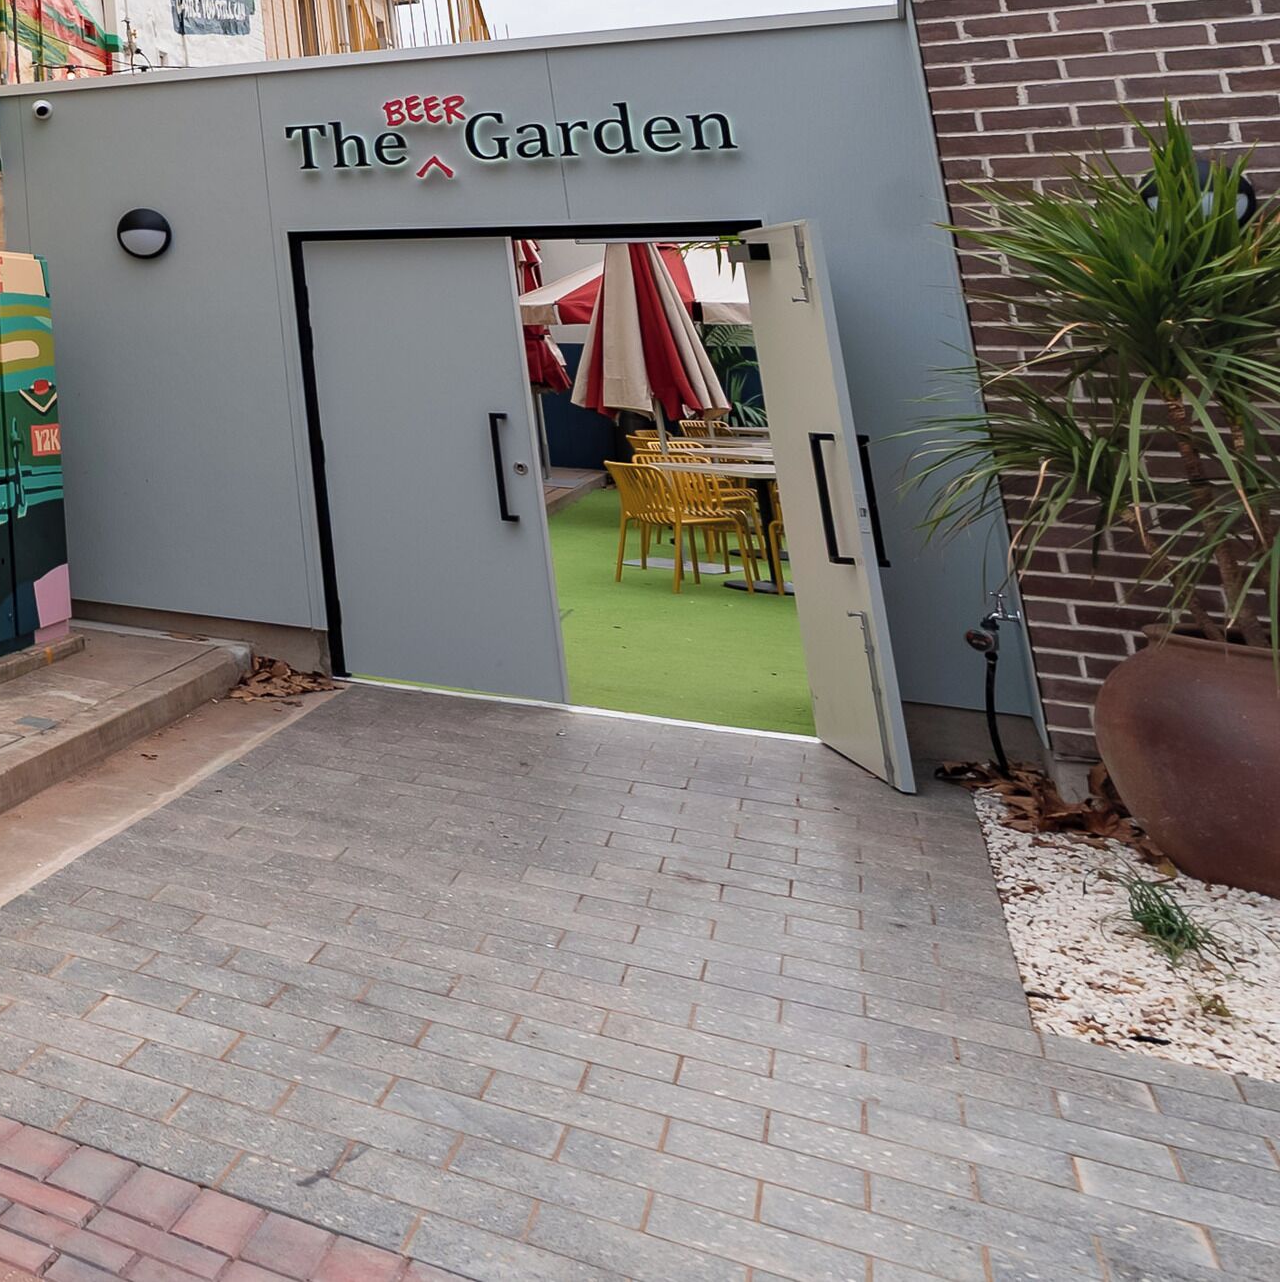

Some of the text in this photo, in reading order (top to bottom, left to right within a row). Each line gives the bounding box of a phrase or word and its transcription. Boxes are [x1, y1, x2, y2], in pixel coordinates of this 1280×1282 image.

[286, 95, 738, 170] The BEER Garden
[34, 427, 61, 452] Y2K
